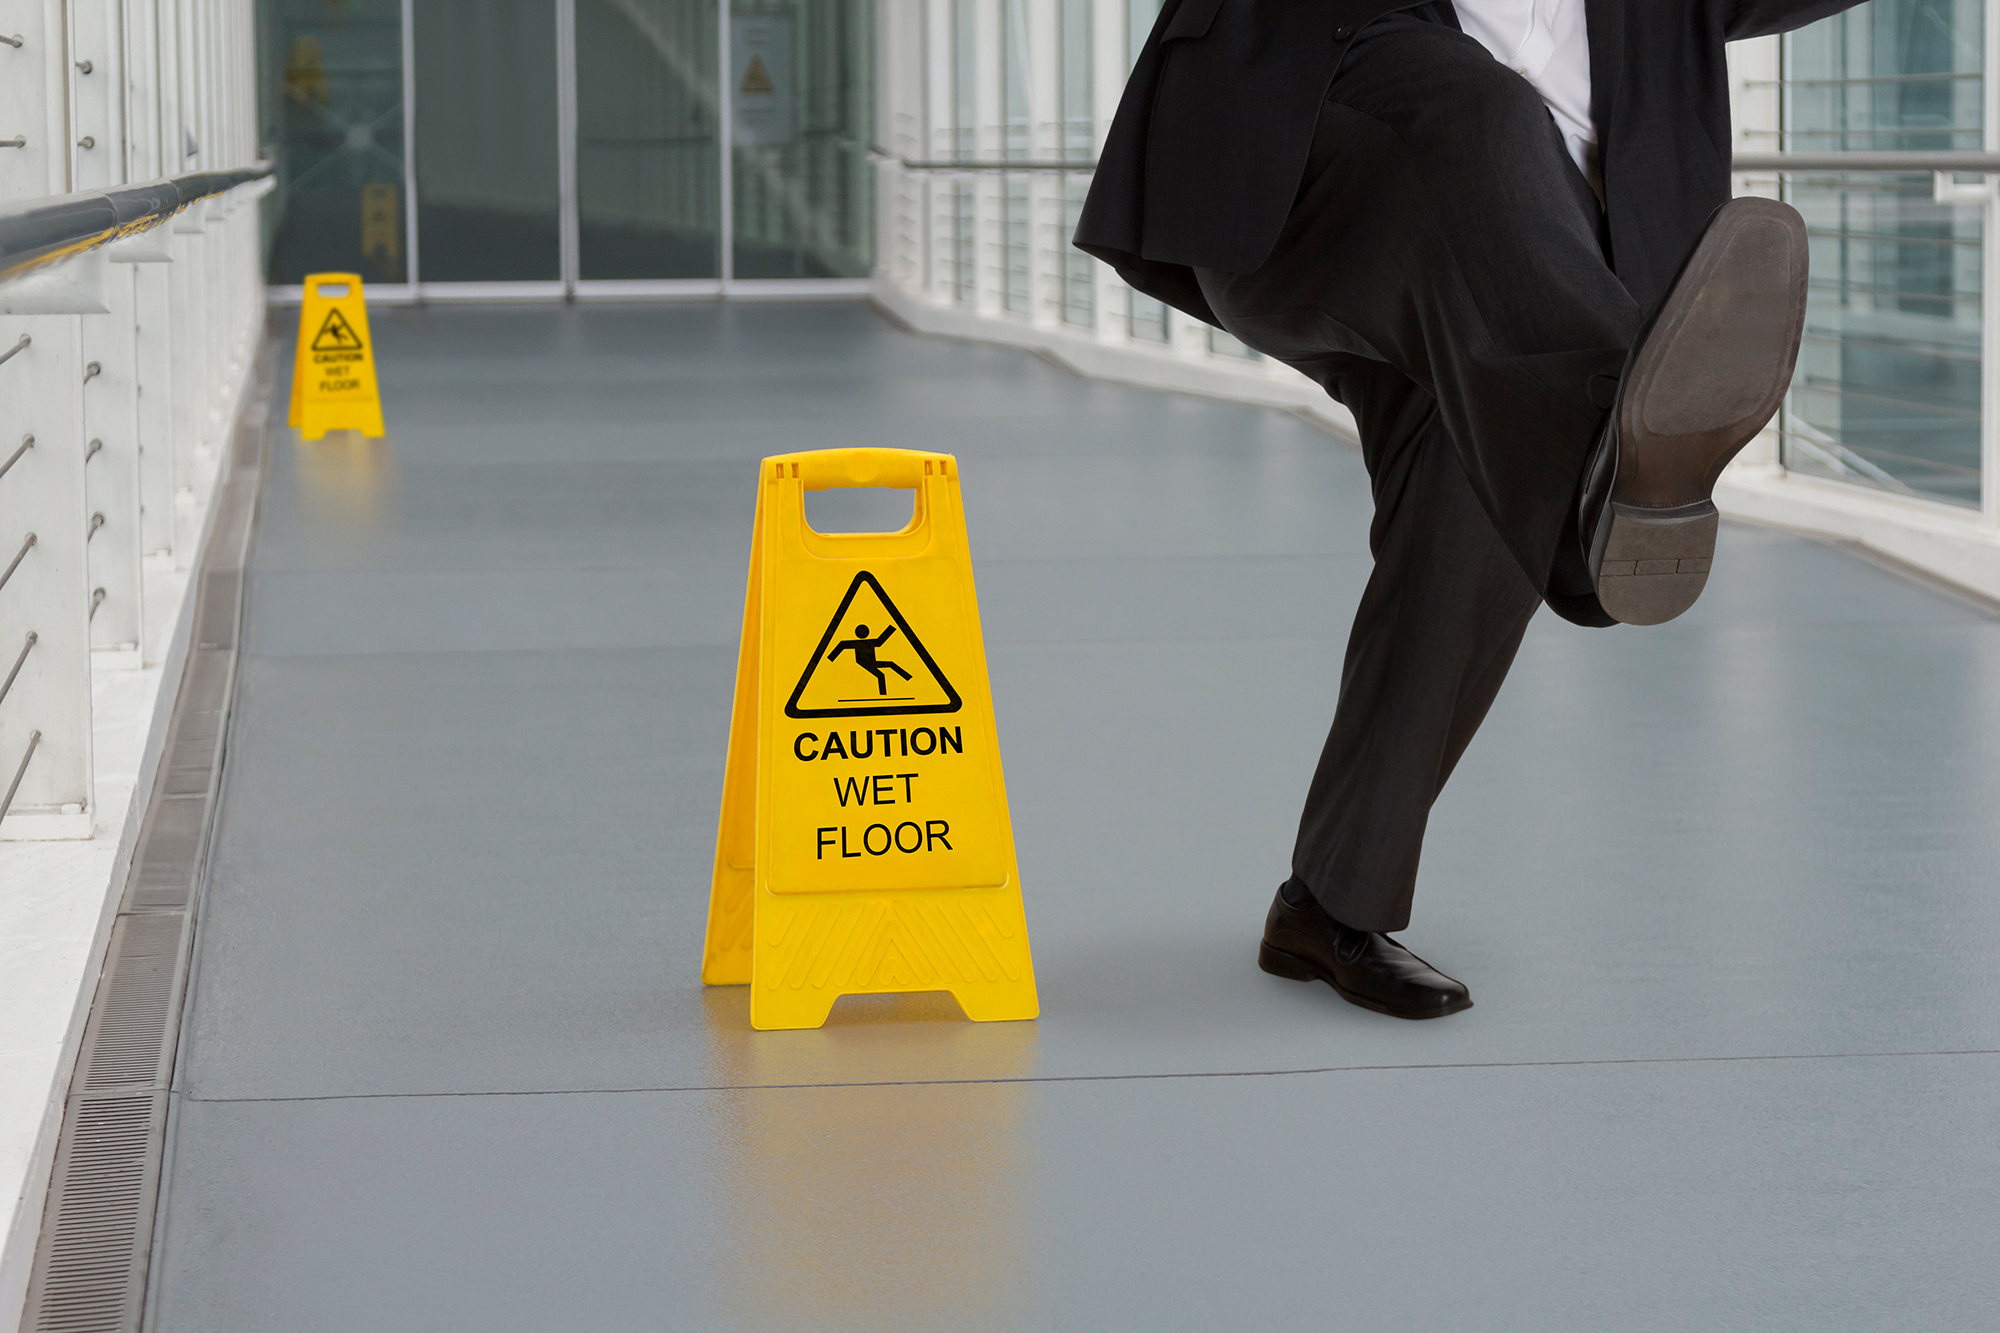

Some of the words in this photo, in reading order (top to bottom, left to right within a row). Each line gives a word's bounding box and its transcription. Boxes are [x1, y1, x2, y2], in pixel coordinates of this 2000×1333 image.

[313, 352, 363, 364] CAUTION
[325, 366, 350, 376] WET
[319, 378, 360, 392] FLOOR
[793, 726, 963, 761] CAUTION
[833, 773, 919, 807] WET
[816, 819, 953, 860] FLOOR
